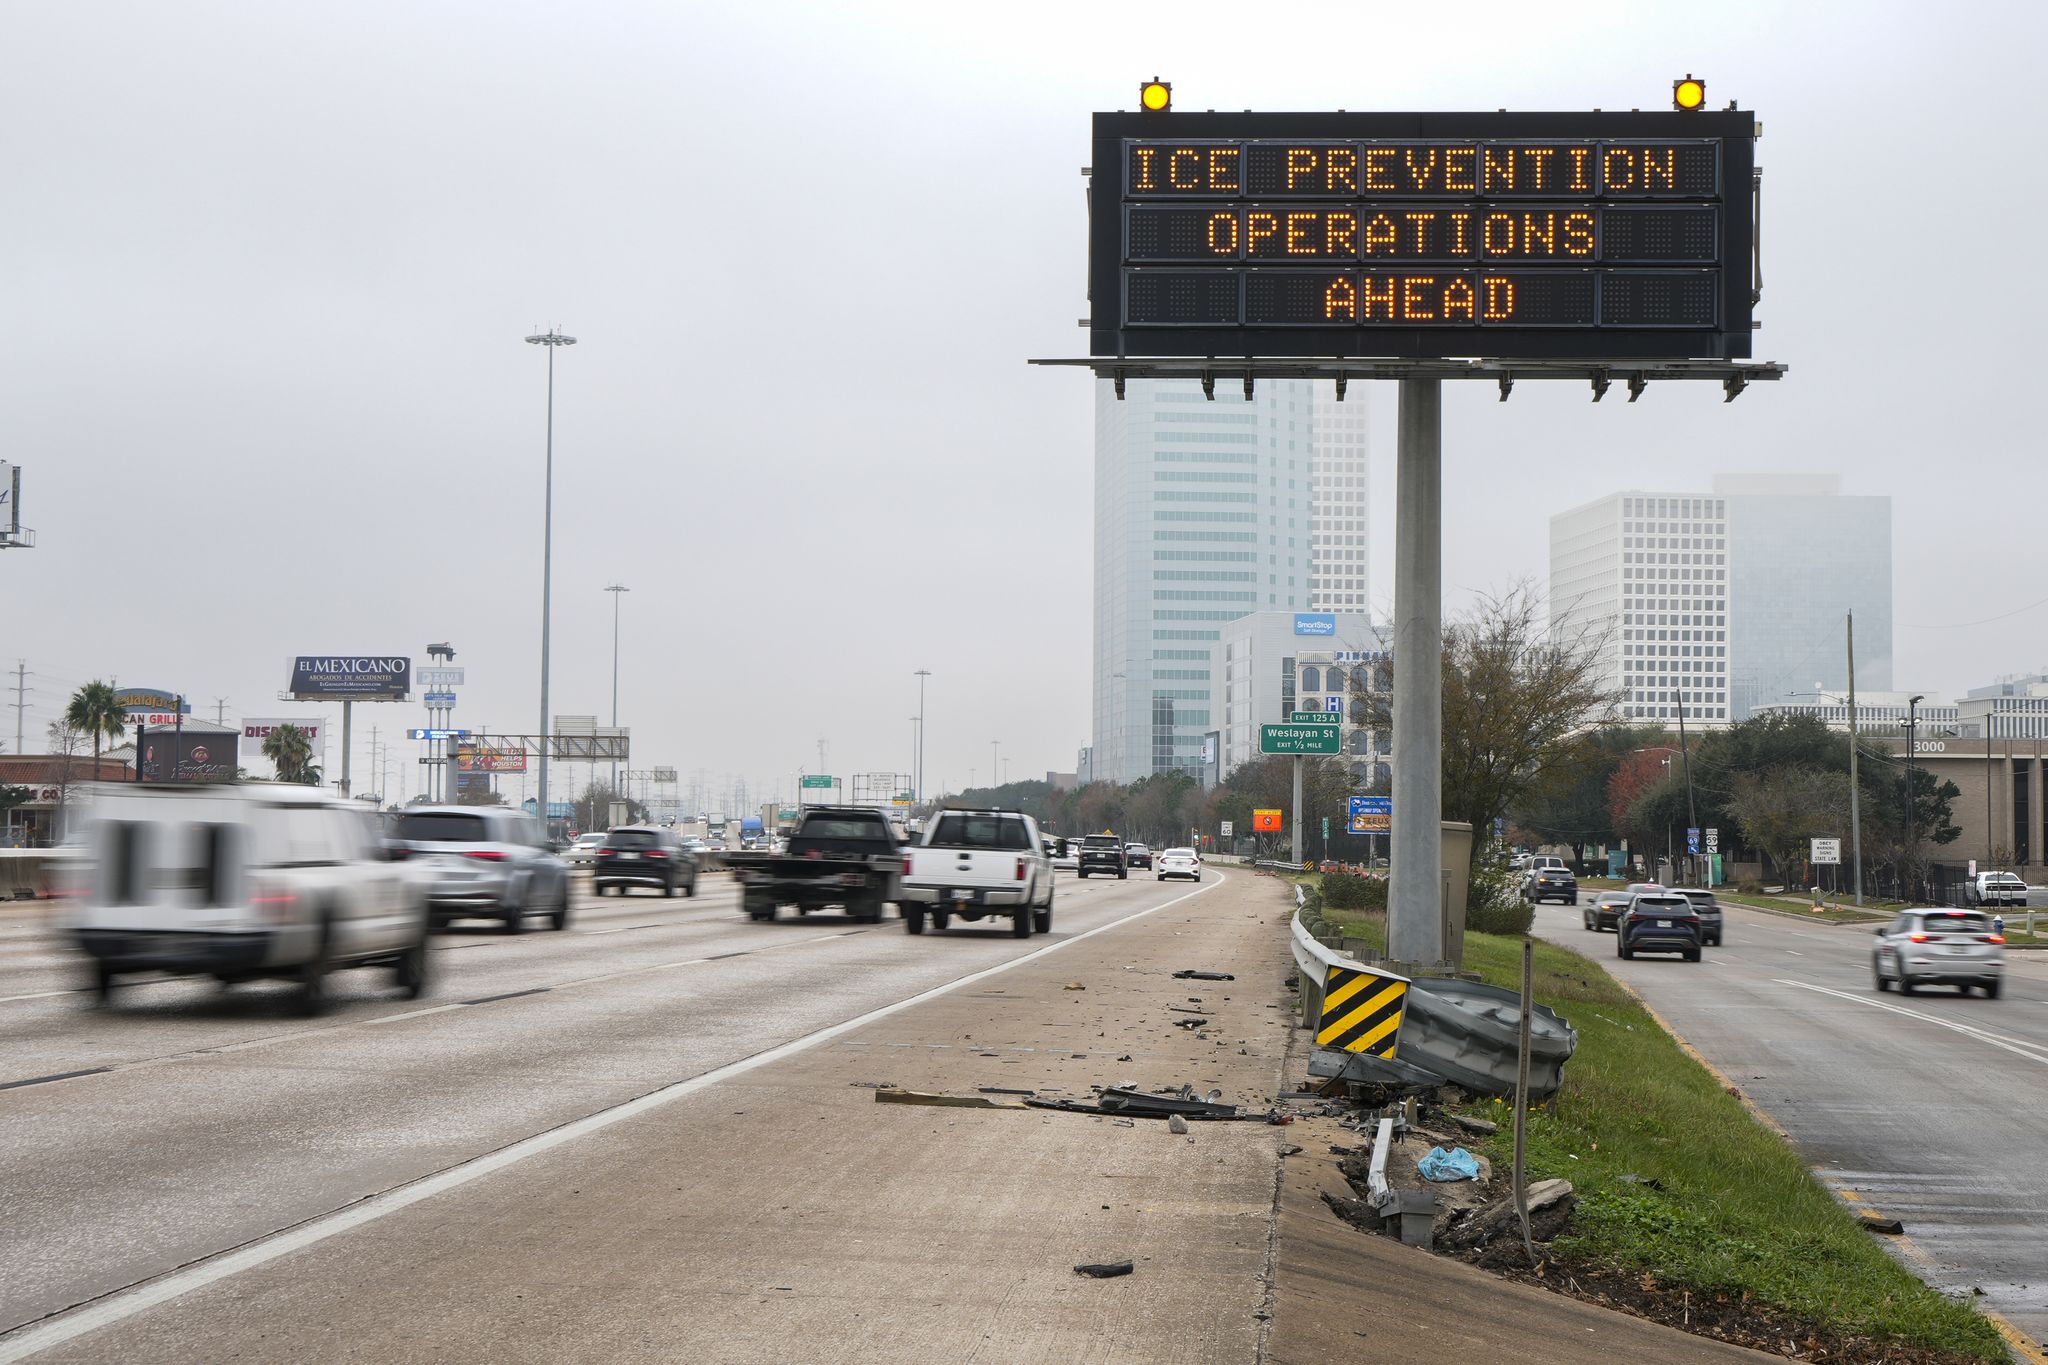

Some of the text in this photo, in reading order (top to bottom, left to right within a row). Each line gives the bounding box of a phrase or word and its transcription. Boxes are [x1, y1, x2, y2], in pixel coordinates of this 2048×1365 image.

[1135, 149, 1675, 190] ICE PREVENTION
[1206, 213, 1595, 255] OPERATIONS
[1324, 277, 1514, 319] AHEAD
[1297, 621, 1333, 630] SmartStop
[300, 659, 406, 673] EL MEXICANO
[1327, 697, 1339, 712] H
[1267, 729, 1334, 740] Weslayan St
[1913, 741, 1945, 752] 3000
[1707, 836, 1717, 844] 59
